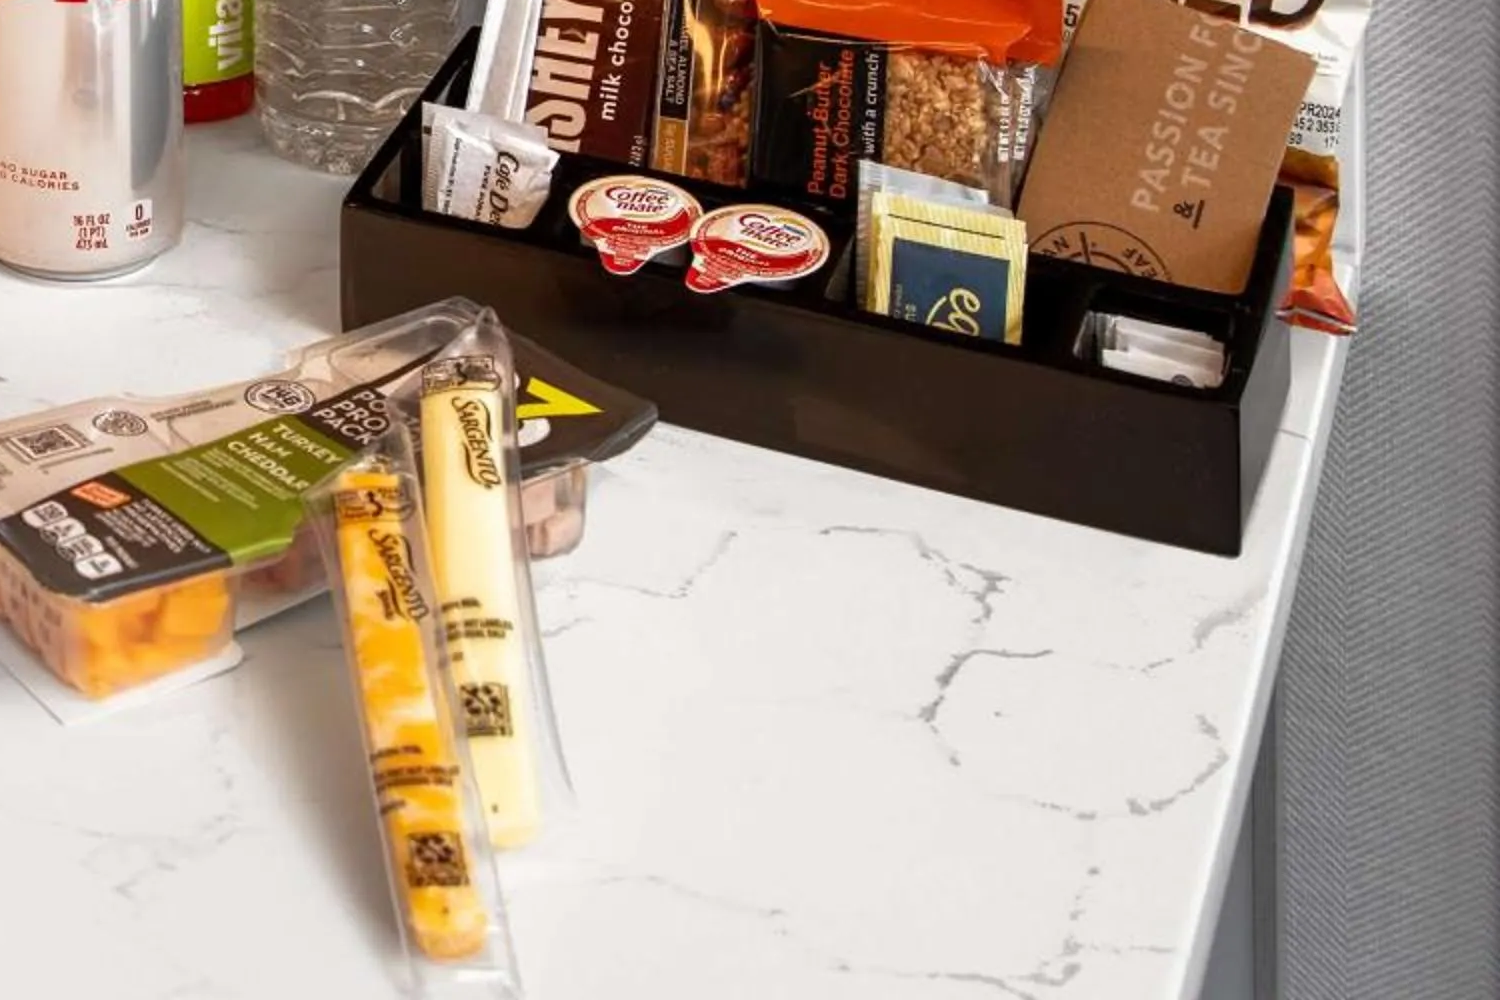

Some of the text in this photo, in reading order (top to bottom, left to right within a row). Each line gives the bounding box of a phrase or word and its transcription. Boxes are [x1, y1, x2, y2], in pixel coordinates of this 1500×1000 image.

[600, 74, 621, 121] milk
[860, 52, 880, 154] with a crunch
[829, 49, 854, 199] Dark Chocolate
[1130, 54, 1210, 213] PASSION
[21, 167, 68, 181] SUGAR
[808, 124, 830, 195] Peanut
[1180, 124, 1230, 190] TEA
[12, 174, 80, 191] CALORIES
[135, 203, 144, 221] 0
[312, 408, 377, 445] PACK
[332, 400, 387, 431] PRO
[248, 431, 293, 459] HAM
[272, 422, 345, 465] TURKEY
[452, 396, 501, 485] SARGENTO
[227, 440, 310, 491] CHEDDAR
